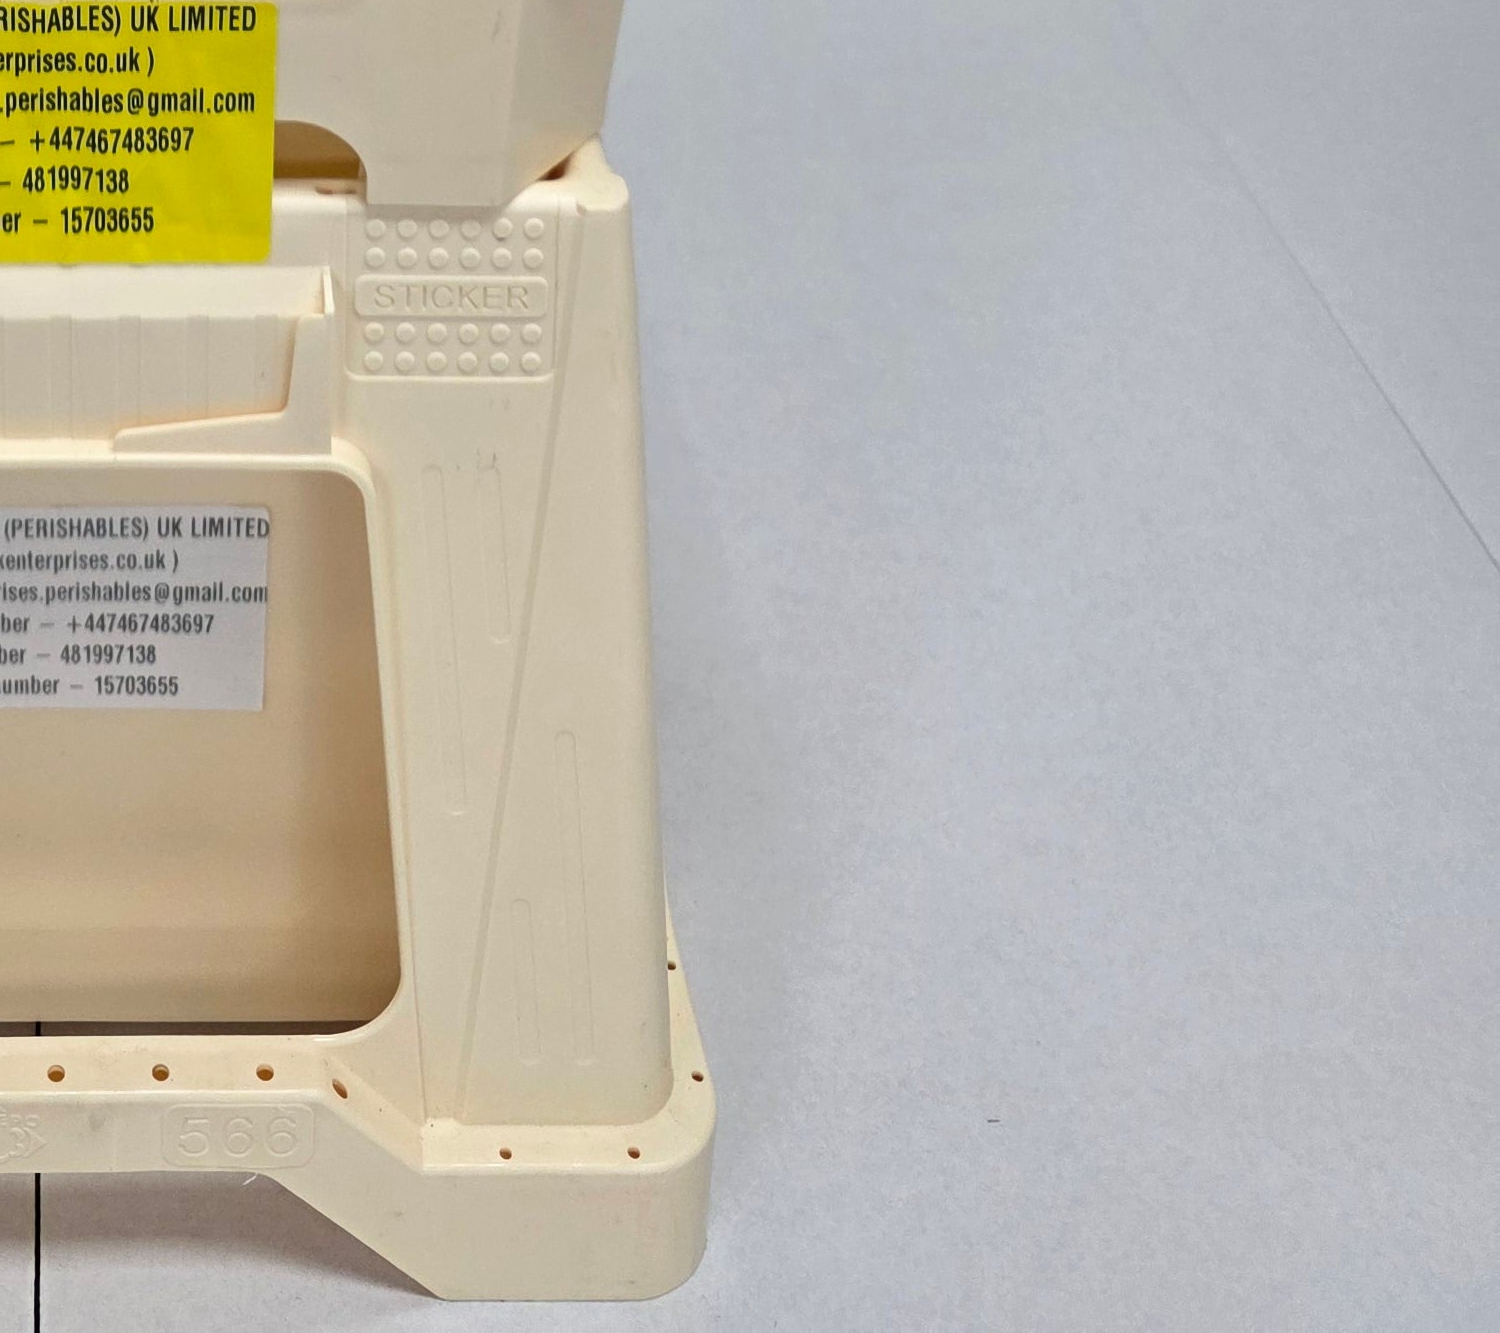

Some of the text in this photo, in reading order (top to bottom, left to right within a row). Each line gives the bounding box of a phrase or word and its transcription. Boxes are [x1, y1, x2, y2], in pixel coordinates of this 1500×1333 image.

[131, 6, 158, 31] UK
[169, 6, 256, 31] LIMITED
[30, 126, 194, 154] +447467483697
[23, 165, 129, 193] 481997138
[61, 207, 153, 234] 15703655
[374, 284, 529, 310] STICKER
[5, 517, 148, 541] (PERISHABLES)
[158, 517, 182, 537] UK
[192, 517, 269, 538] LIMITED
[68, 613, 214, 634] +447467483697
[61, 645, 156, 664] 481997138
[95, 676, 178, 696] 15703655
[178, 1115, 298, 1159] 566
